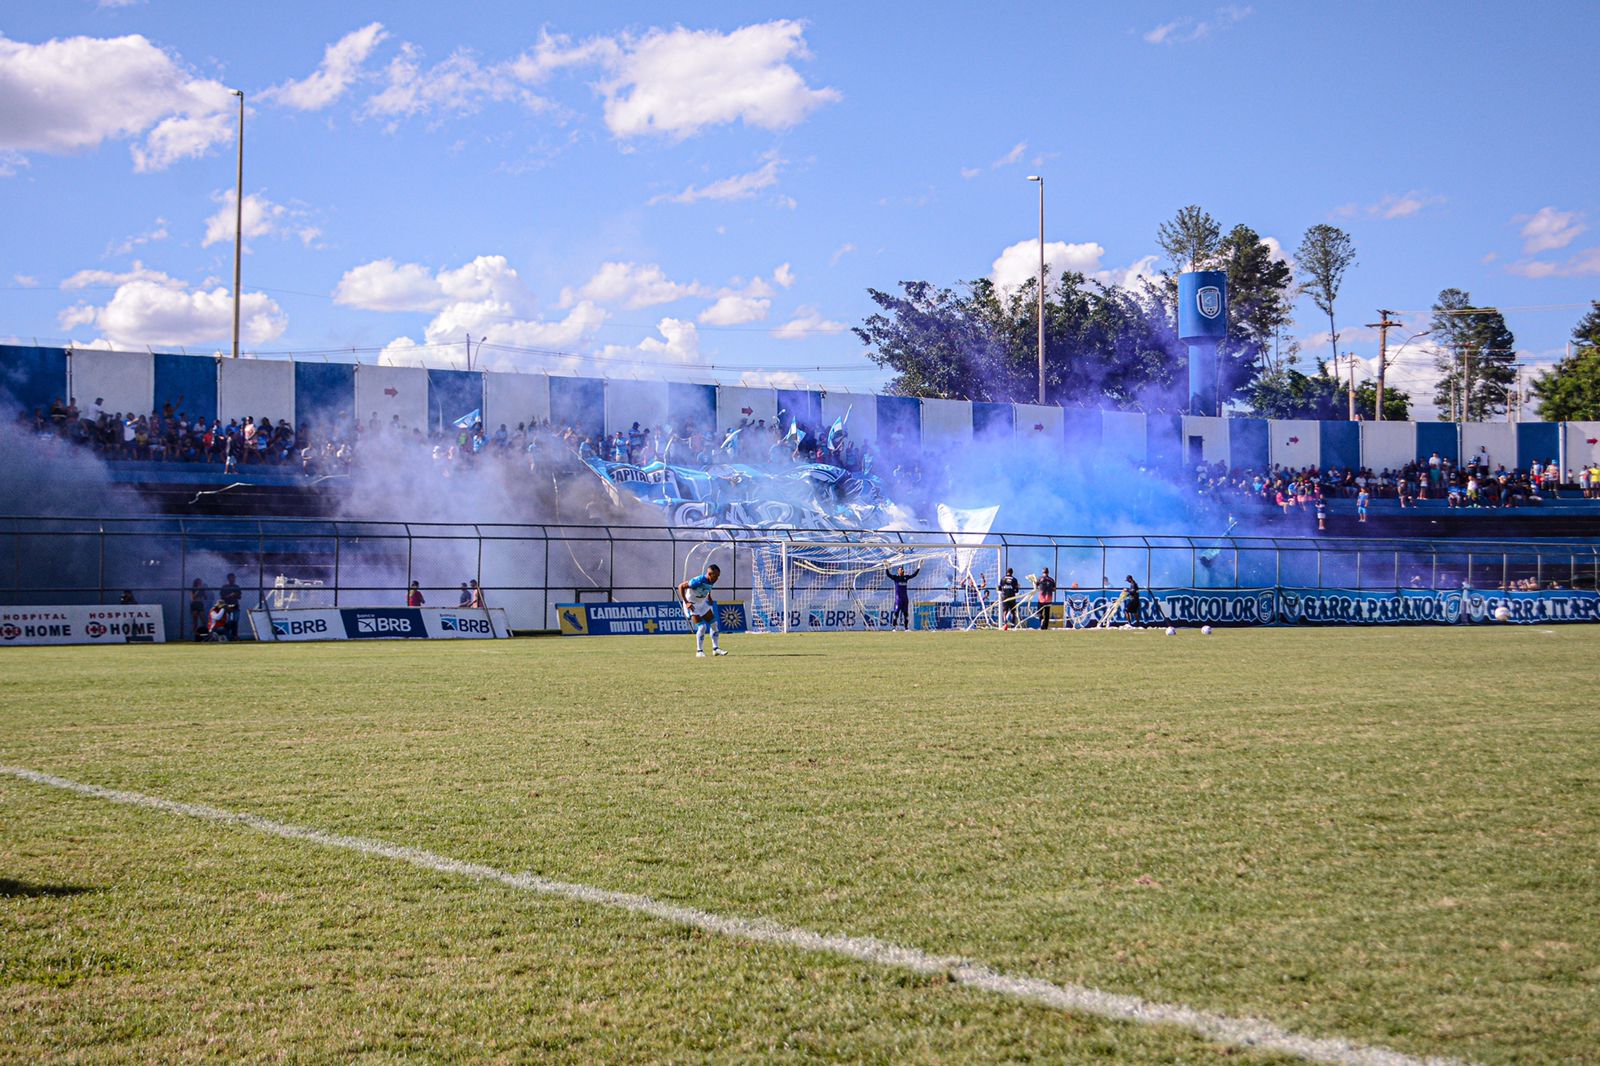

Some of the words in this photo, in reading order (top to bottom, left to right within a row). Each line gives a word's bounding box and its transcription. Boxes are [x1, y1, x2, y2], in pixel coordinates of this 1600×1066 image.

[1166, 595, 1258, 624] TRICOLOR
[1303, 596, 1365, 623] GARRA
[377, 617, 411, 632] BRB
[458, 618, 490, 633] BRB
[825, 610, 856, 627] BRB
[25, 625, 71, 636] HOME
[111, 623, 155, 635] HOME
[291, 619, 327, 635] BRB
[609, 621, 643, 633] MUITO
